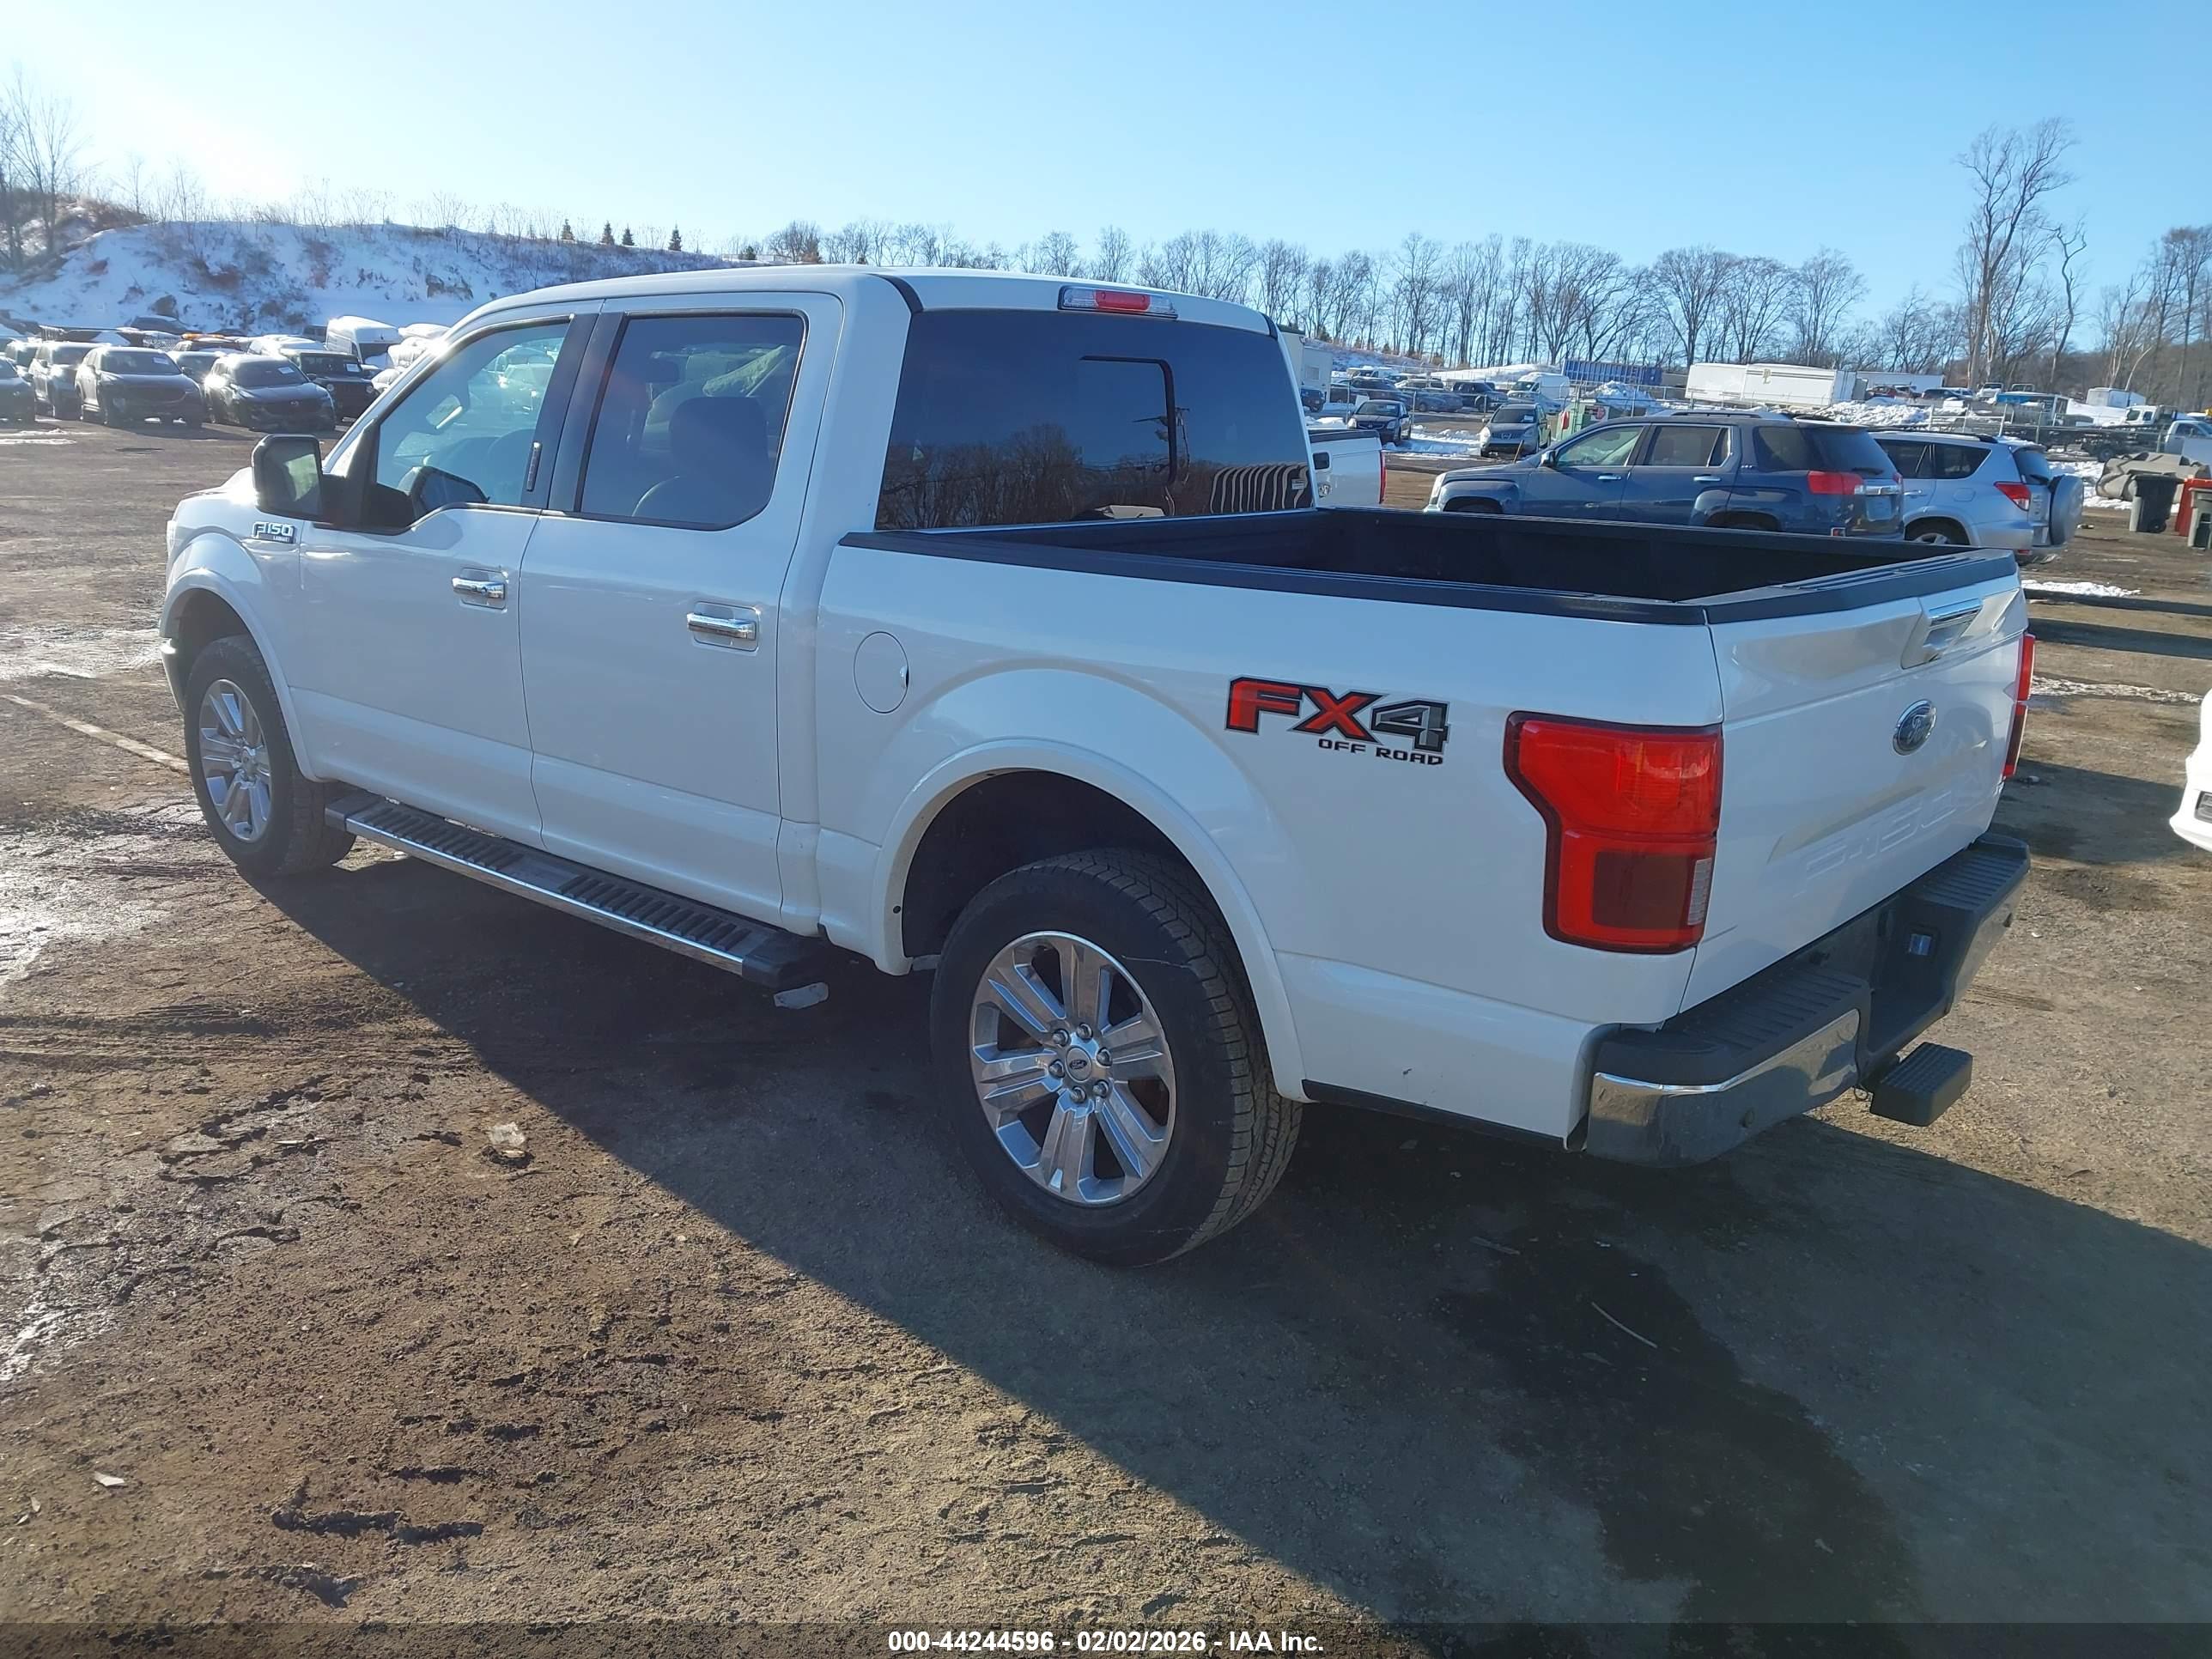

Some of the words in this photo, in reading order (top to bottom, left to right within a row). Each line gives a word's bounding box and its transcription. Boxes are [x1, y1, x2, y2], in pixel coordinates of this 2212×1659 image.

[1225, 676, 1449, 753] FX4
[1318, 738, 1366, 754] OFF
[1376, 746, 1443, 766] ROAD
